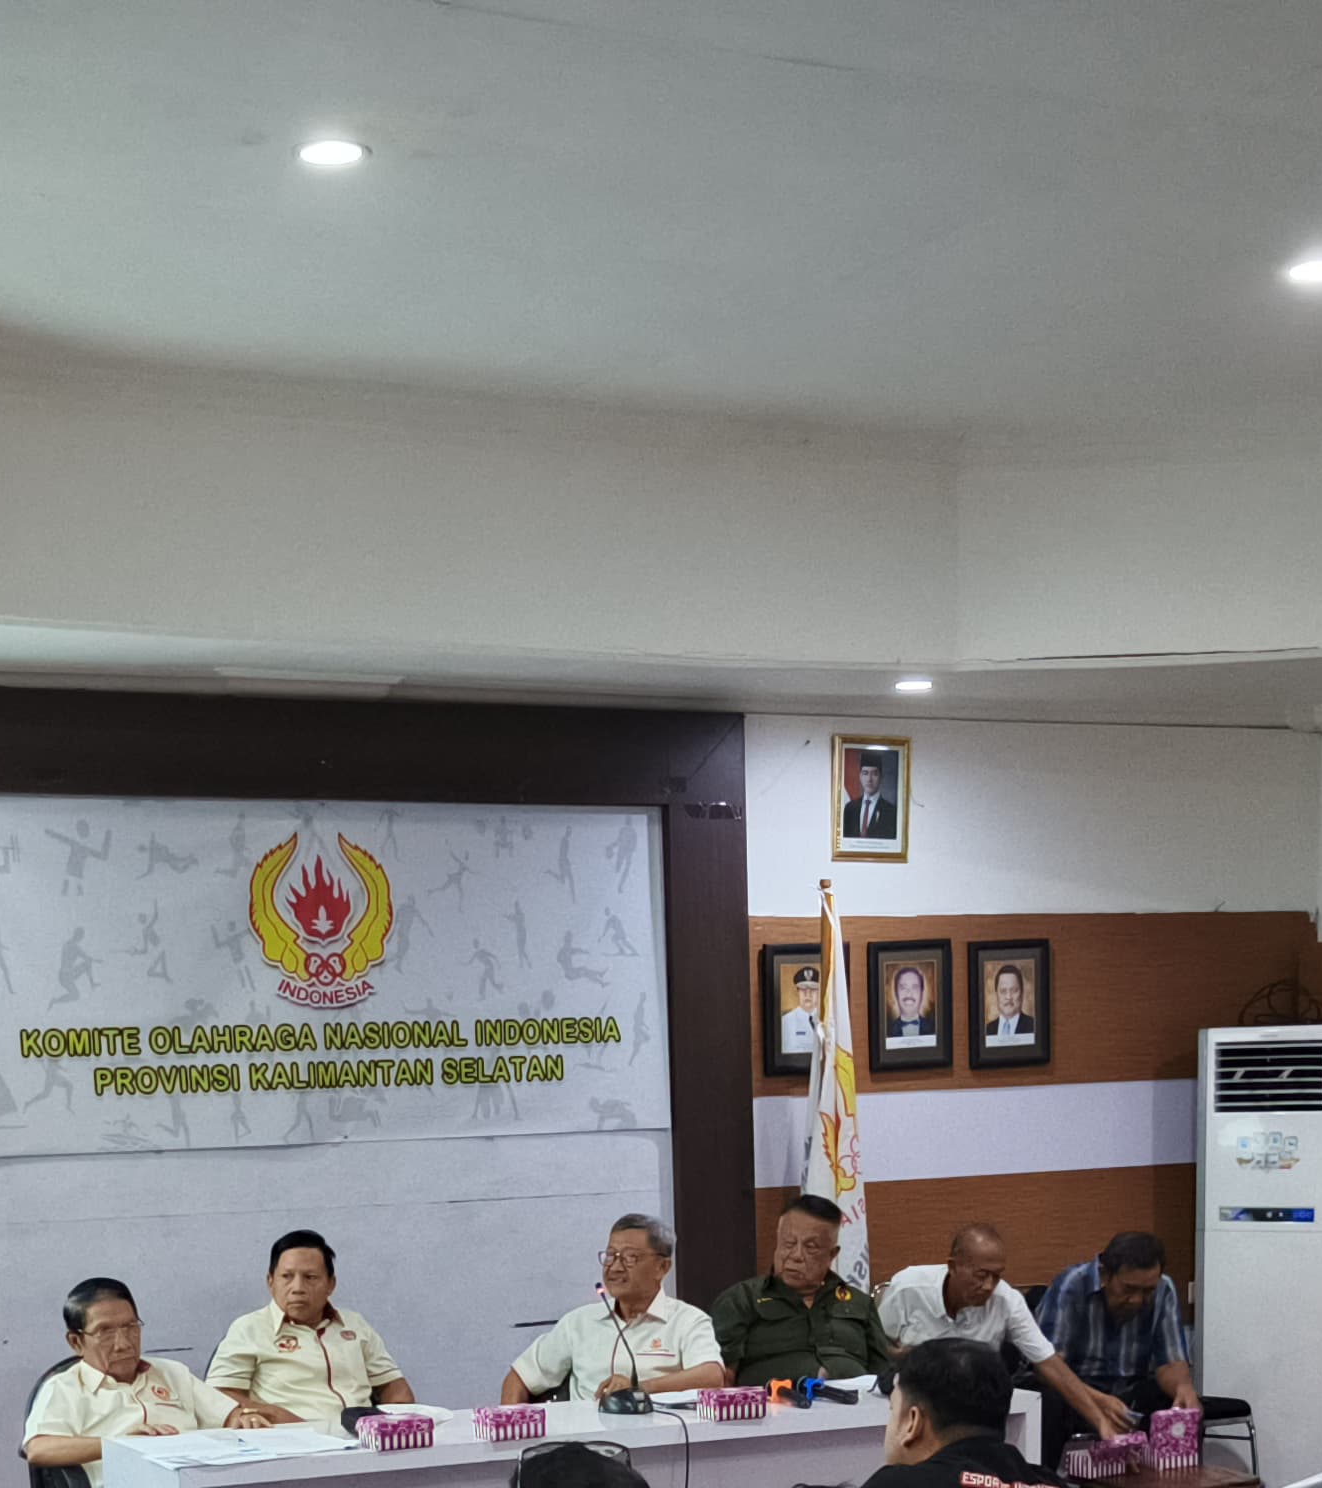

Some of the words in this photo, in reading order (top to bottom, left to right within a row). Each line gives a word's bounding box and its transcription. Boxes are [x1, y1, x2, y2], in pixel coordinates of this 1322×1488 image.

[278, 979, 375, 1005] INDONESIA
[19, 1026, 142, 1058] KOMITE
[148, 1022, 318, 1055] OLAHRAGA
[324, 1019, 469, 1051] NASIONAL
[474, 1016, 622, 1048] INDONESIA
[93, 1062, 241, 1096] PROVINSI
[248, 1057, 434, 1091] KALIMANTAN
[440, 1054, 565, 1085] SELATAN
